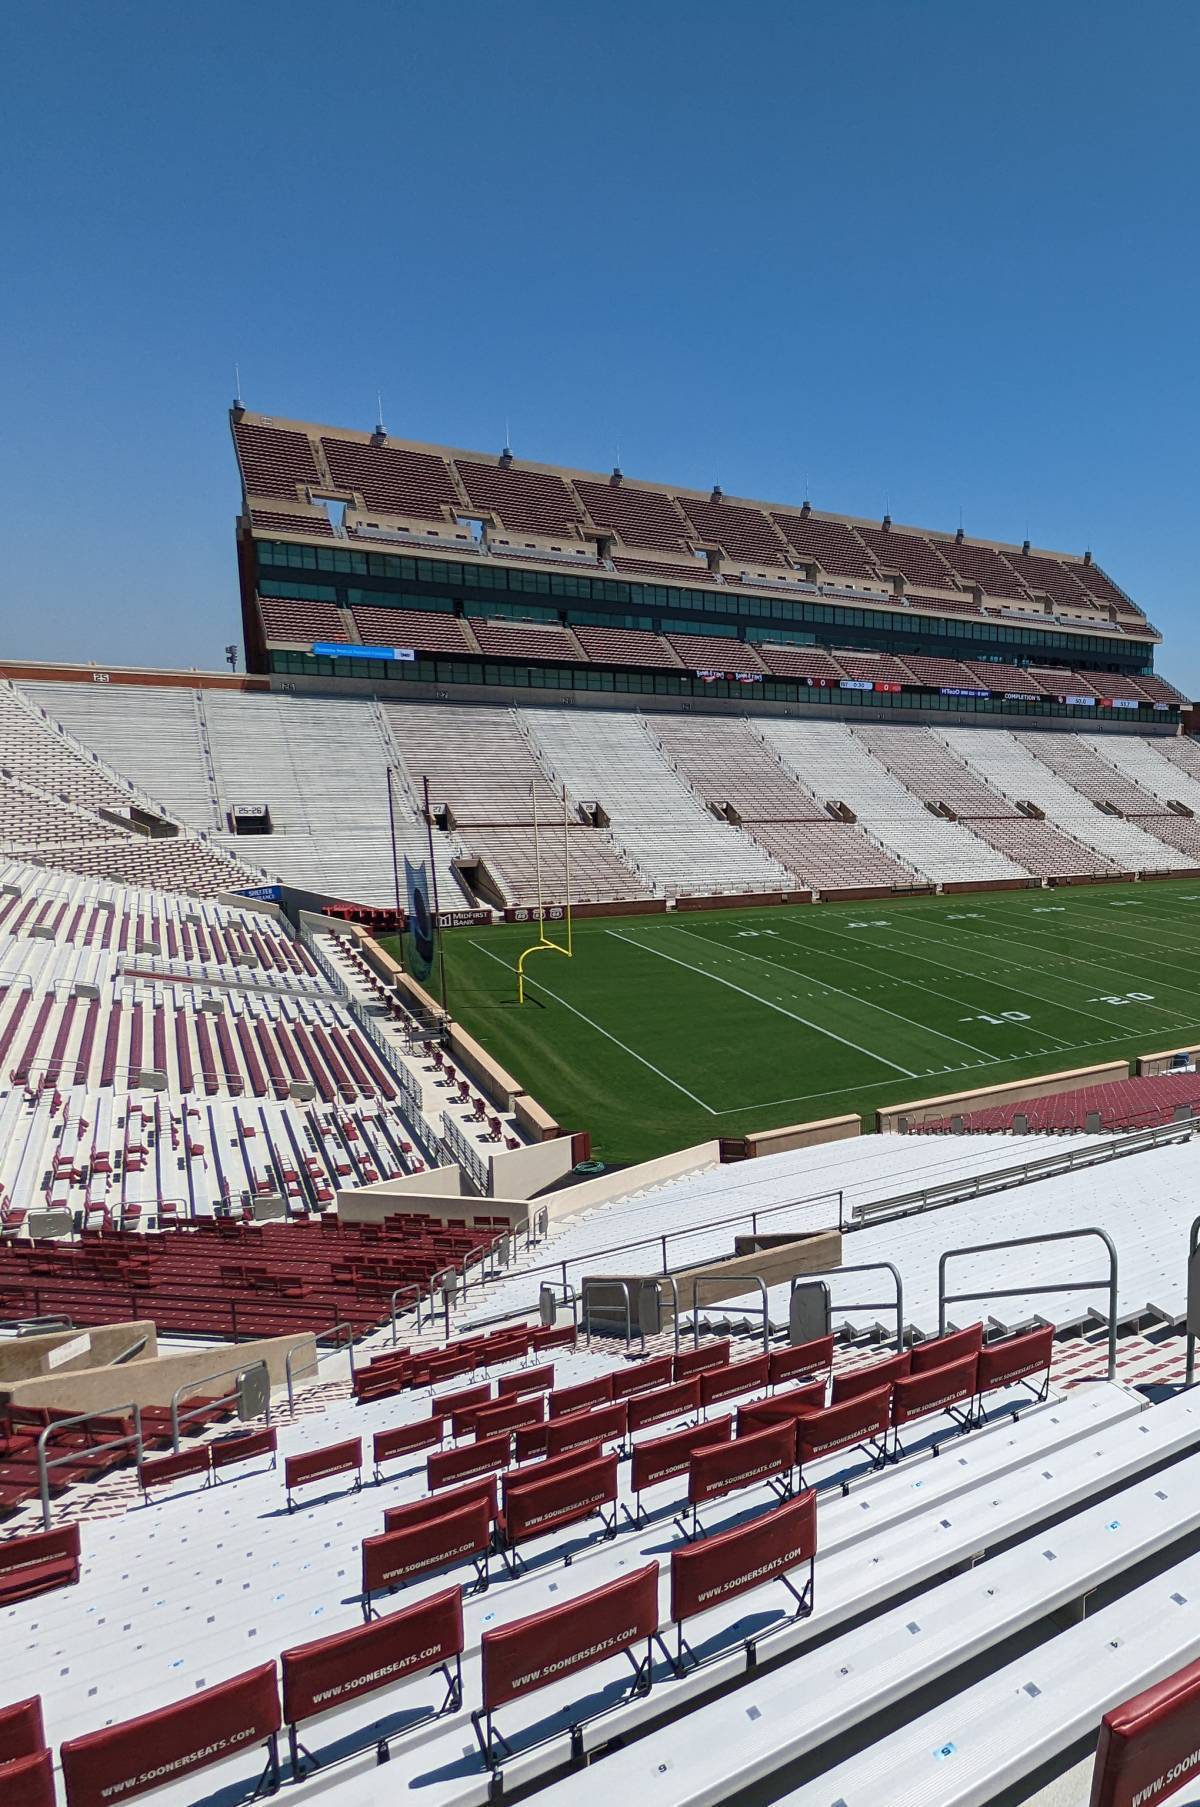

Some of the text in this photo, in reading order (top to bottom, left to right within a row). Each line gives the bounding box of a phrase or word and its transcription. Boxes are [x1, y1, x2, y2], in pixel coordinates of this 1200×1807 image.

[238, 806, 262, 815] 25-26
[1100, 992, 1155, 1005] 20
[976, 1011, 1031, 1025] 10
[706, 1460, 782, 1492] WWW.SOONERSEATS.COM
[524, 1493, 605, 1527] WWW.SOONERSEATS.COM
[382, 1541, 475, 1580] WWW.SOONERSEATS.COM
[697, 1548, 802, 1603] WWW.SOONERSEATS.COM
[313, 1644, 442, 1703] WWW.SOONERSEATS.COM
[511, 1626, 638, 1689] WWW.SOONERSEATS.COM
[101, 1727, 256, 1797] WWW.SOONERSEATS.COM
